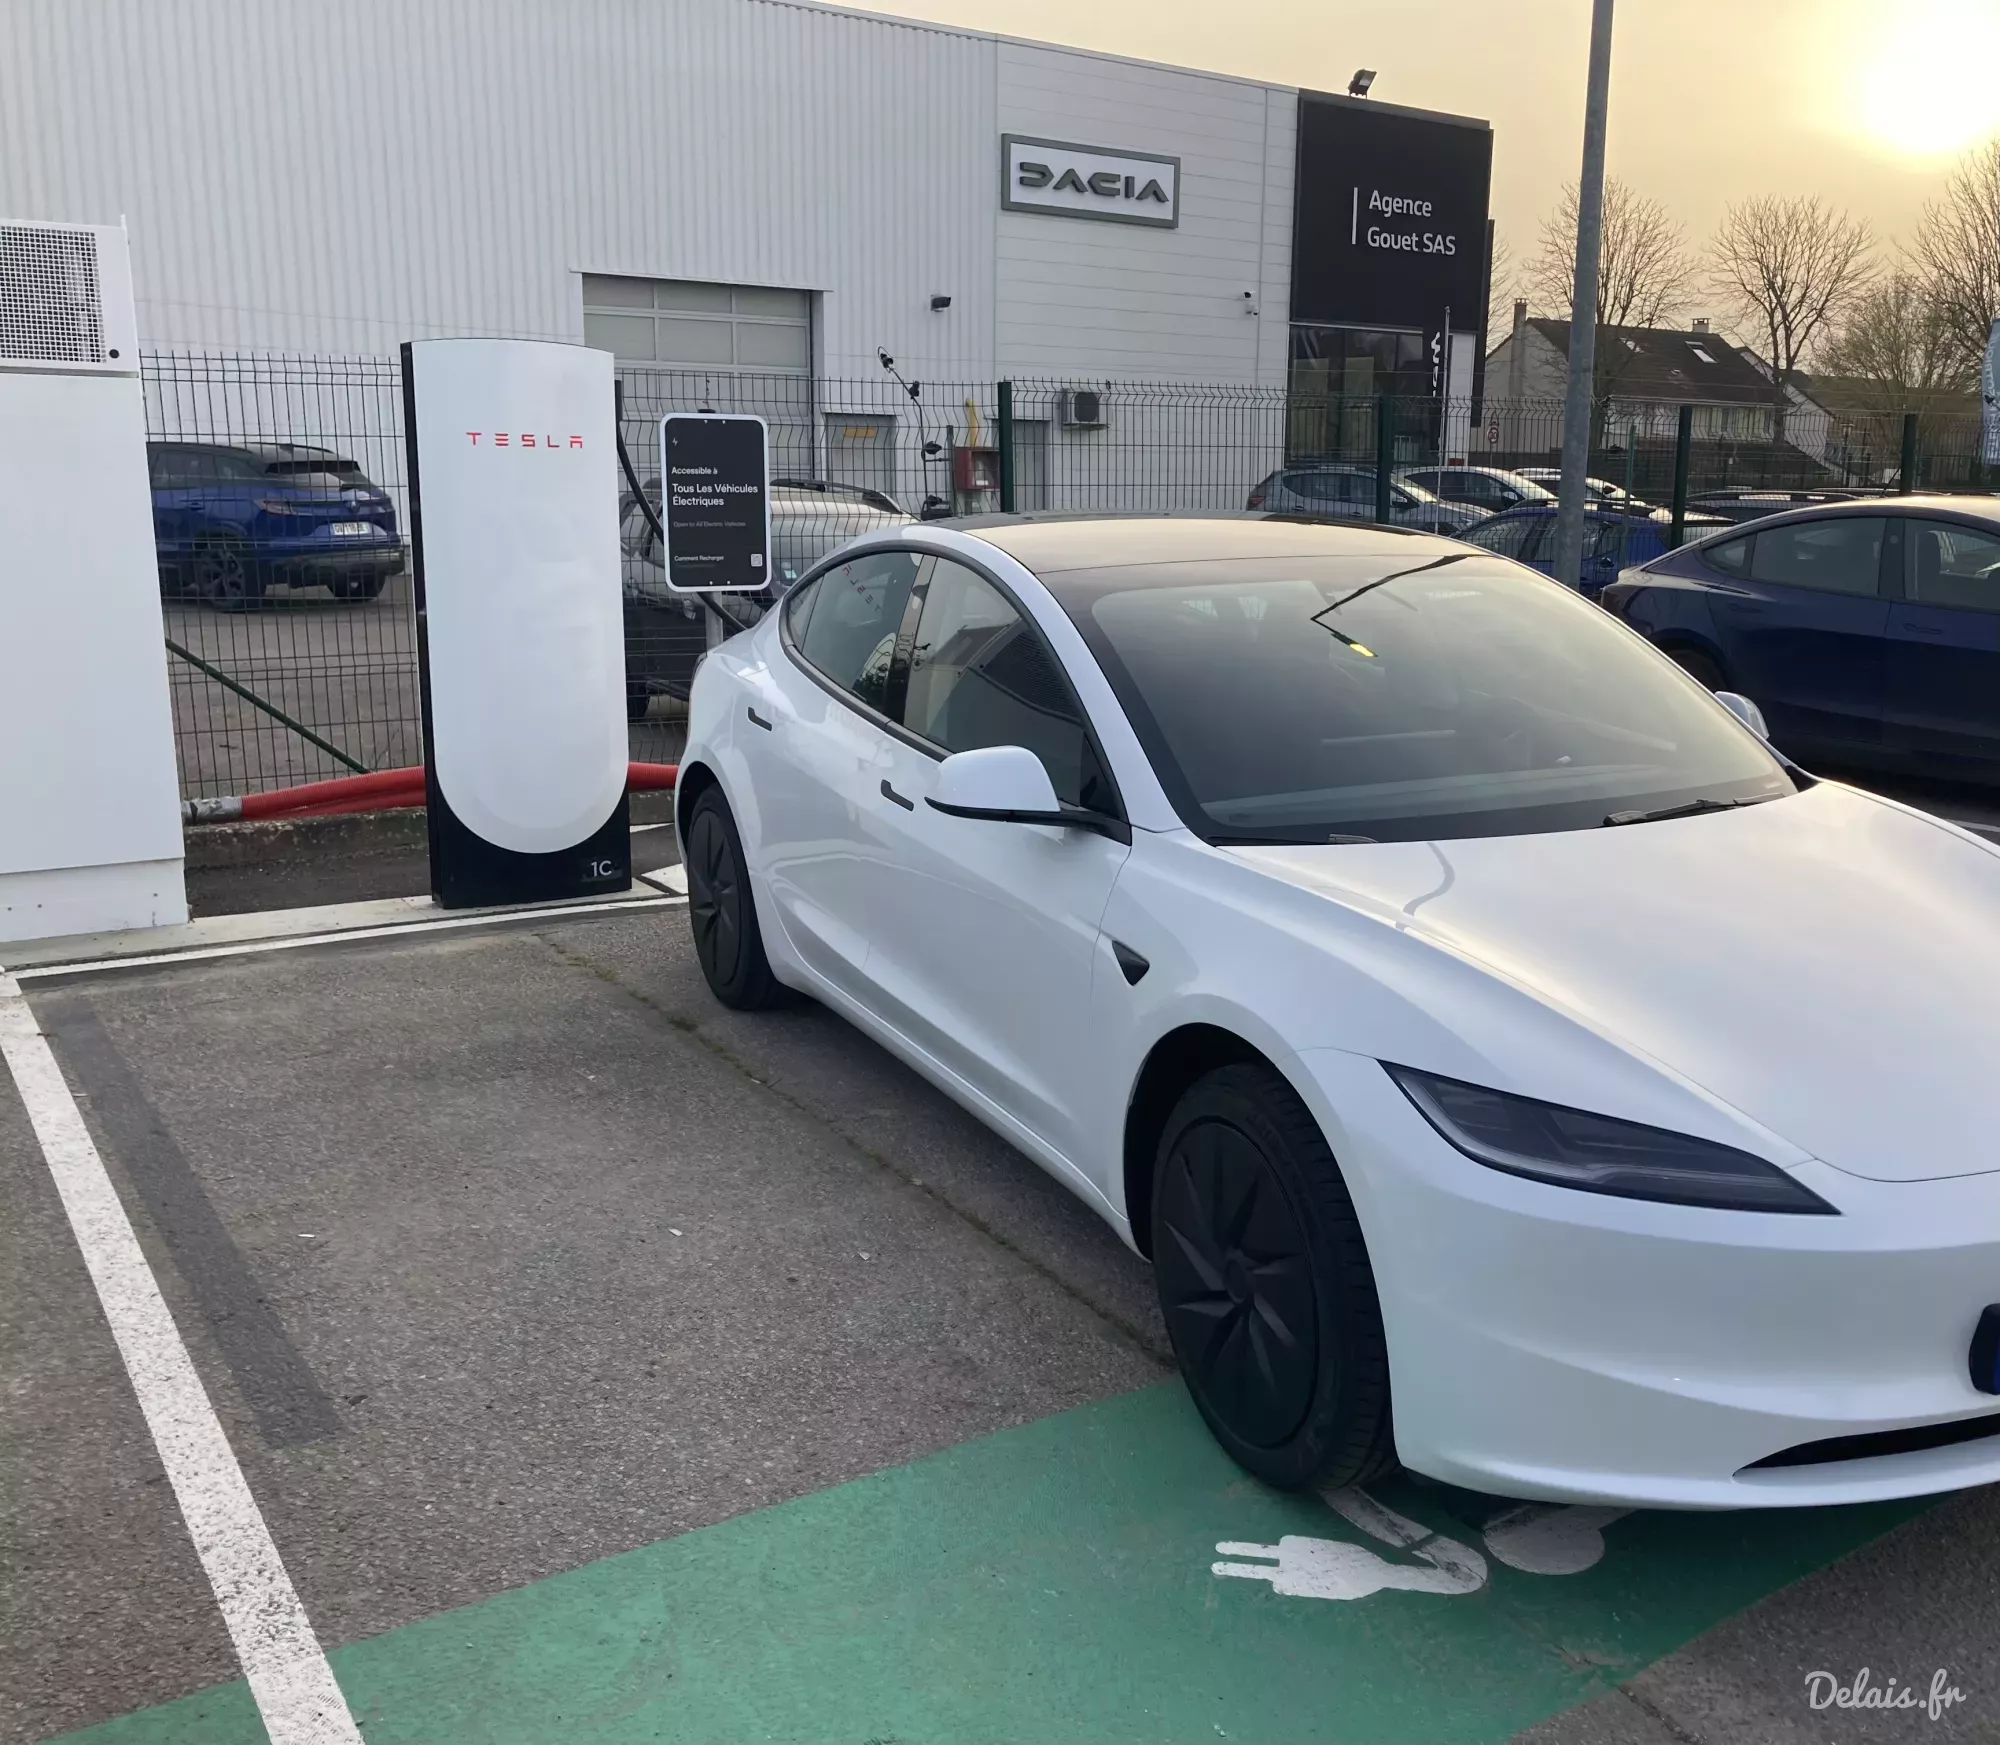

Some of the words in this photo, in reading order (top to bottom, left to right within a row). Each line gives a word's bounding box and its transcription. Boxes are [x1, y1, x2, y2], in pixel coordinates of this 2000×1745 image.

[1019, 161, 1169, 203] DACIA
[1368, 189, 1432, 218] Agence
[1367, 226, 1419, 252] Gouet
[1422, 232, 1456, 255] SAS
[466, 431, 584, 449] TESLA
[671, 466, 712, 475] Accessible
[713, 467, 718, 475] à
[672, 483, 694, 493] Tous
[696, 483, 712, 493] Les
[714, 483, 758, 494] Véhicules
[672, 494, 724, 507] Électriques
[590, 860, 612, 877] 1C
